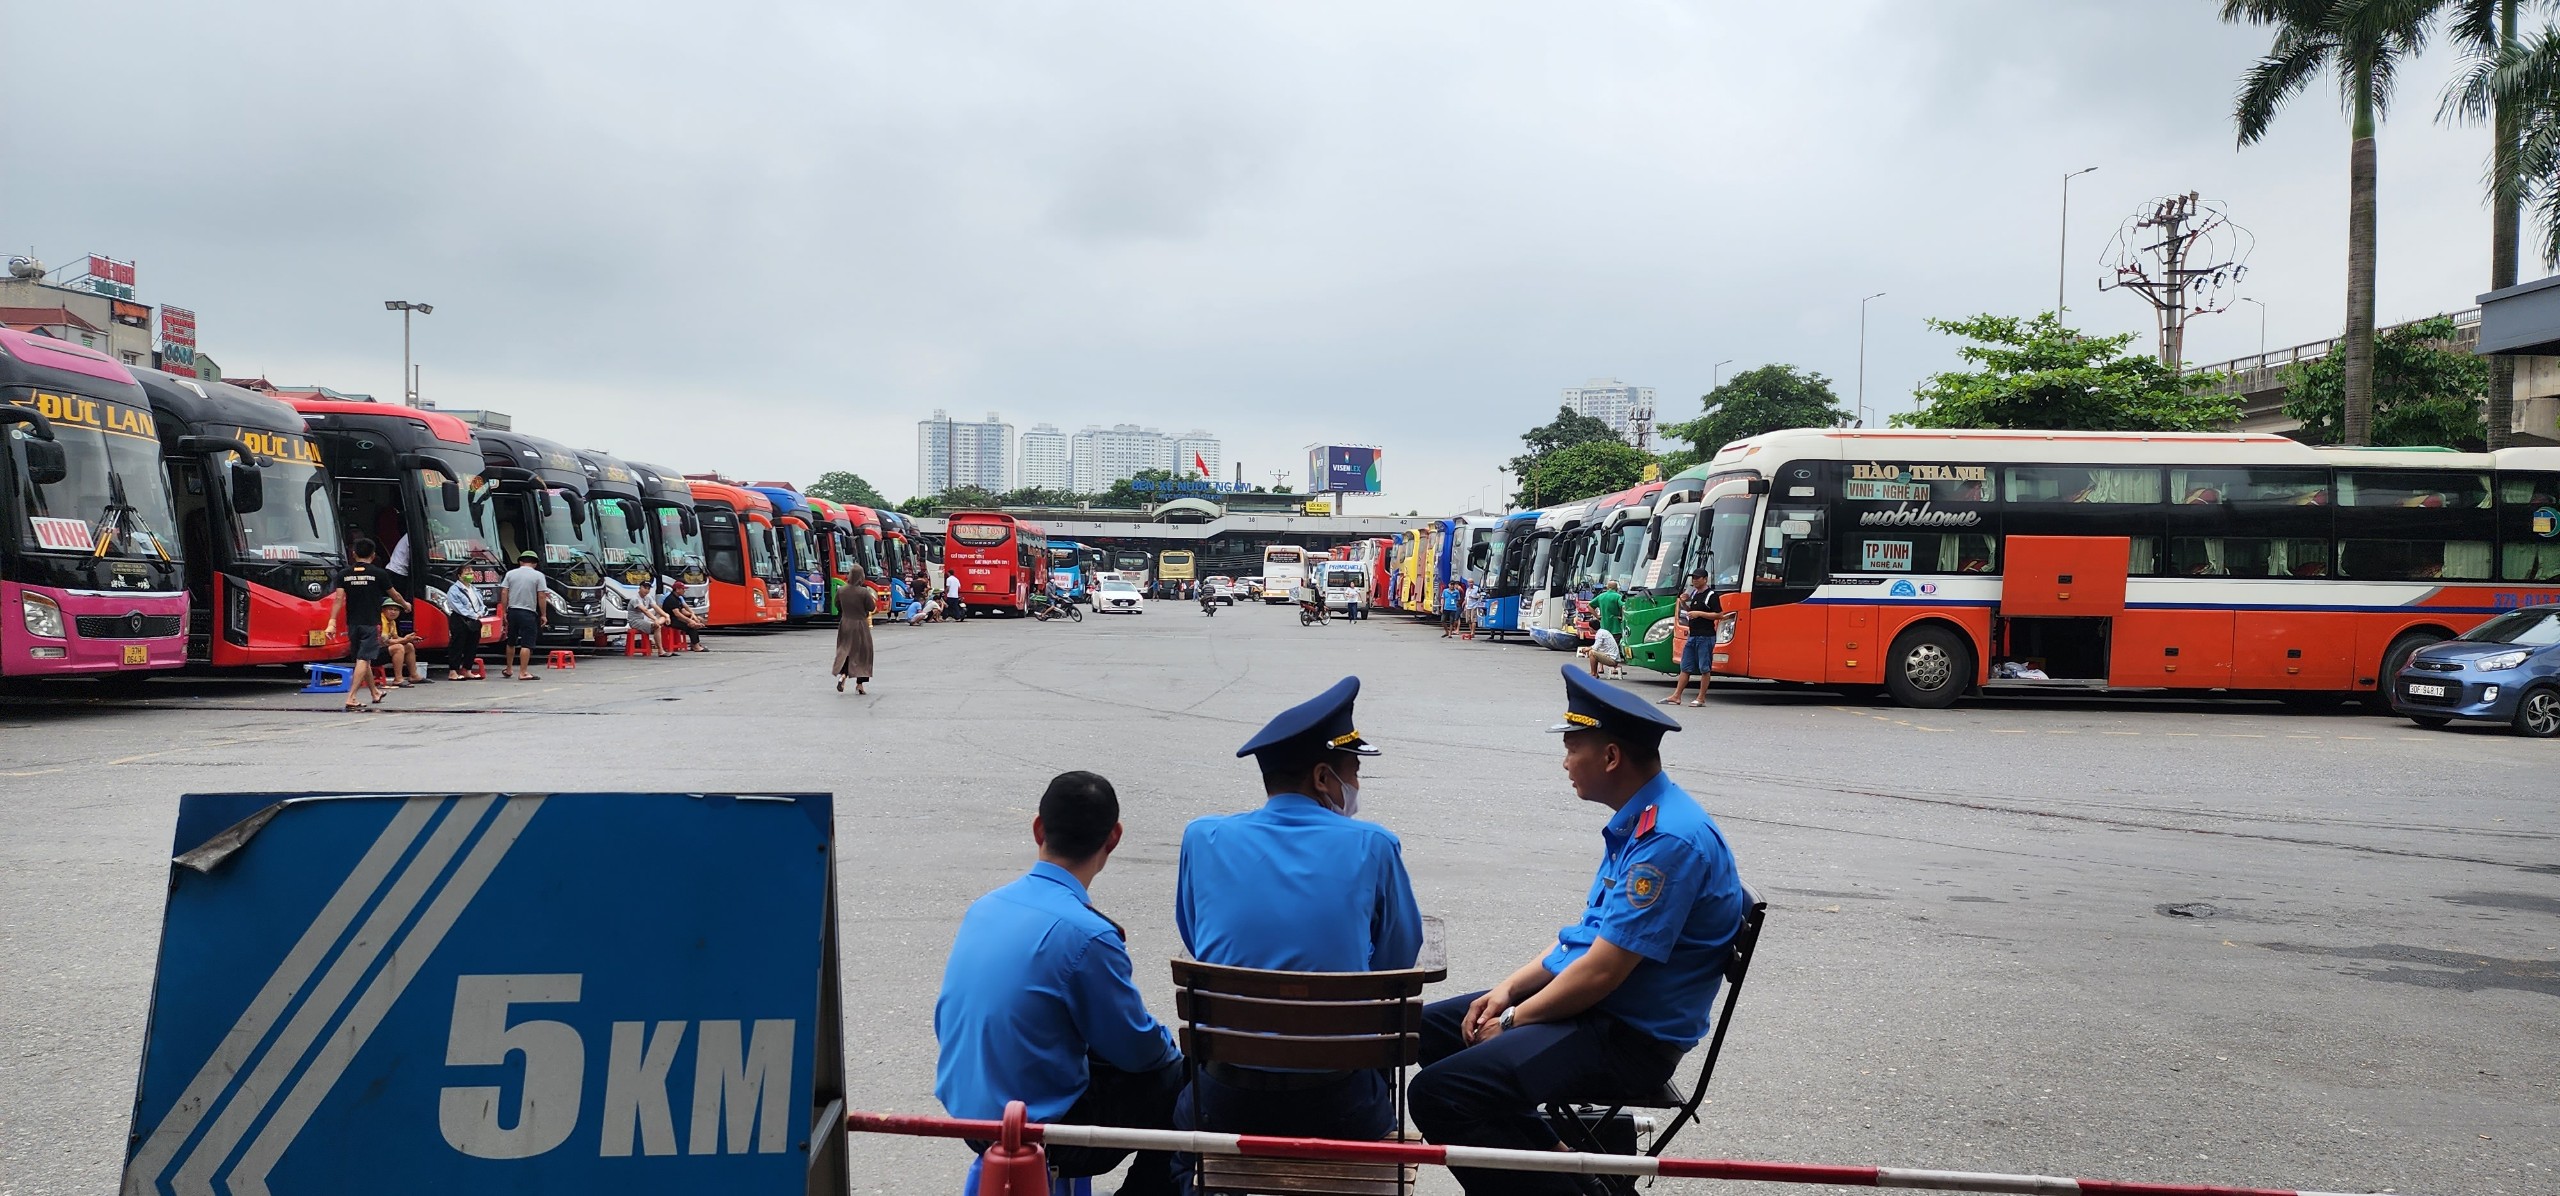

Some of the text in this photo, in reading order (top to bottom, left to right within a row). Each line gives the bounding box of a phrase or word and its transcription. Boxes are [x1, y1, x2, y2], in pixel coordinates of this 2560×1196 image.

[106, 405, 155, 436] LAN
[293, 439, 322, 462] LAN
[1852, 461, 1987, 480] HÀO THANH
[1160, 480, 1174, 491] XE
[1849, 483, 1875, 497] VINH
[1913, 487, 1929, 500] AN
[1860, 501, 1981, 526] mobihome
[37, 521, 92, 548] VINH
[605, 549, 625, 562] VINH
[1866, 544, 1909, 559] TP VINH
[439, 973, 796, 1160] 5 KM
